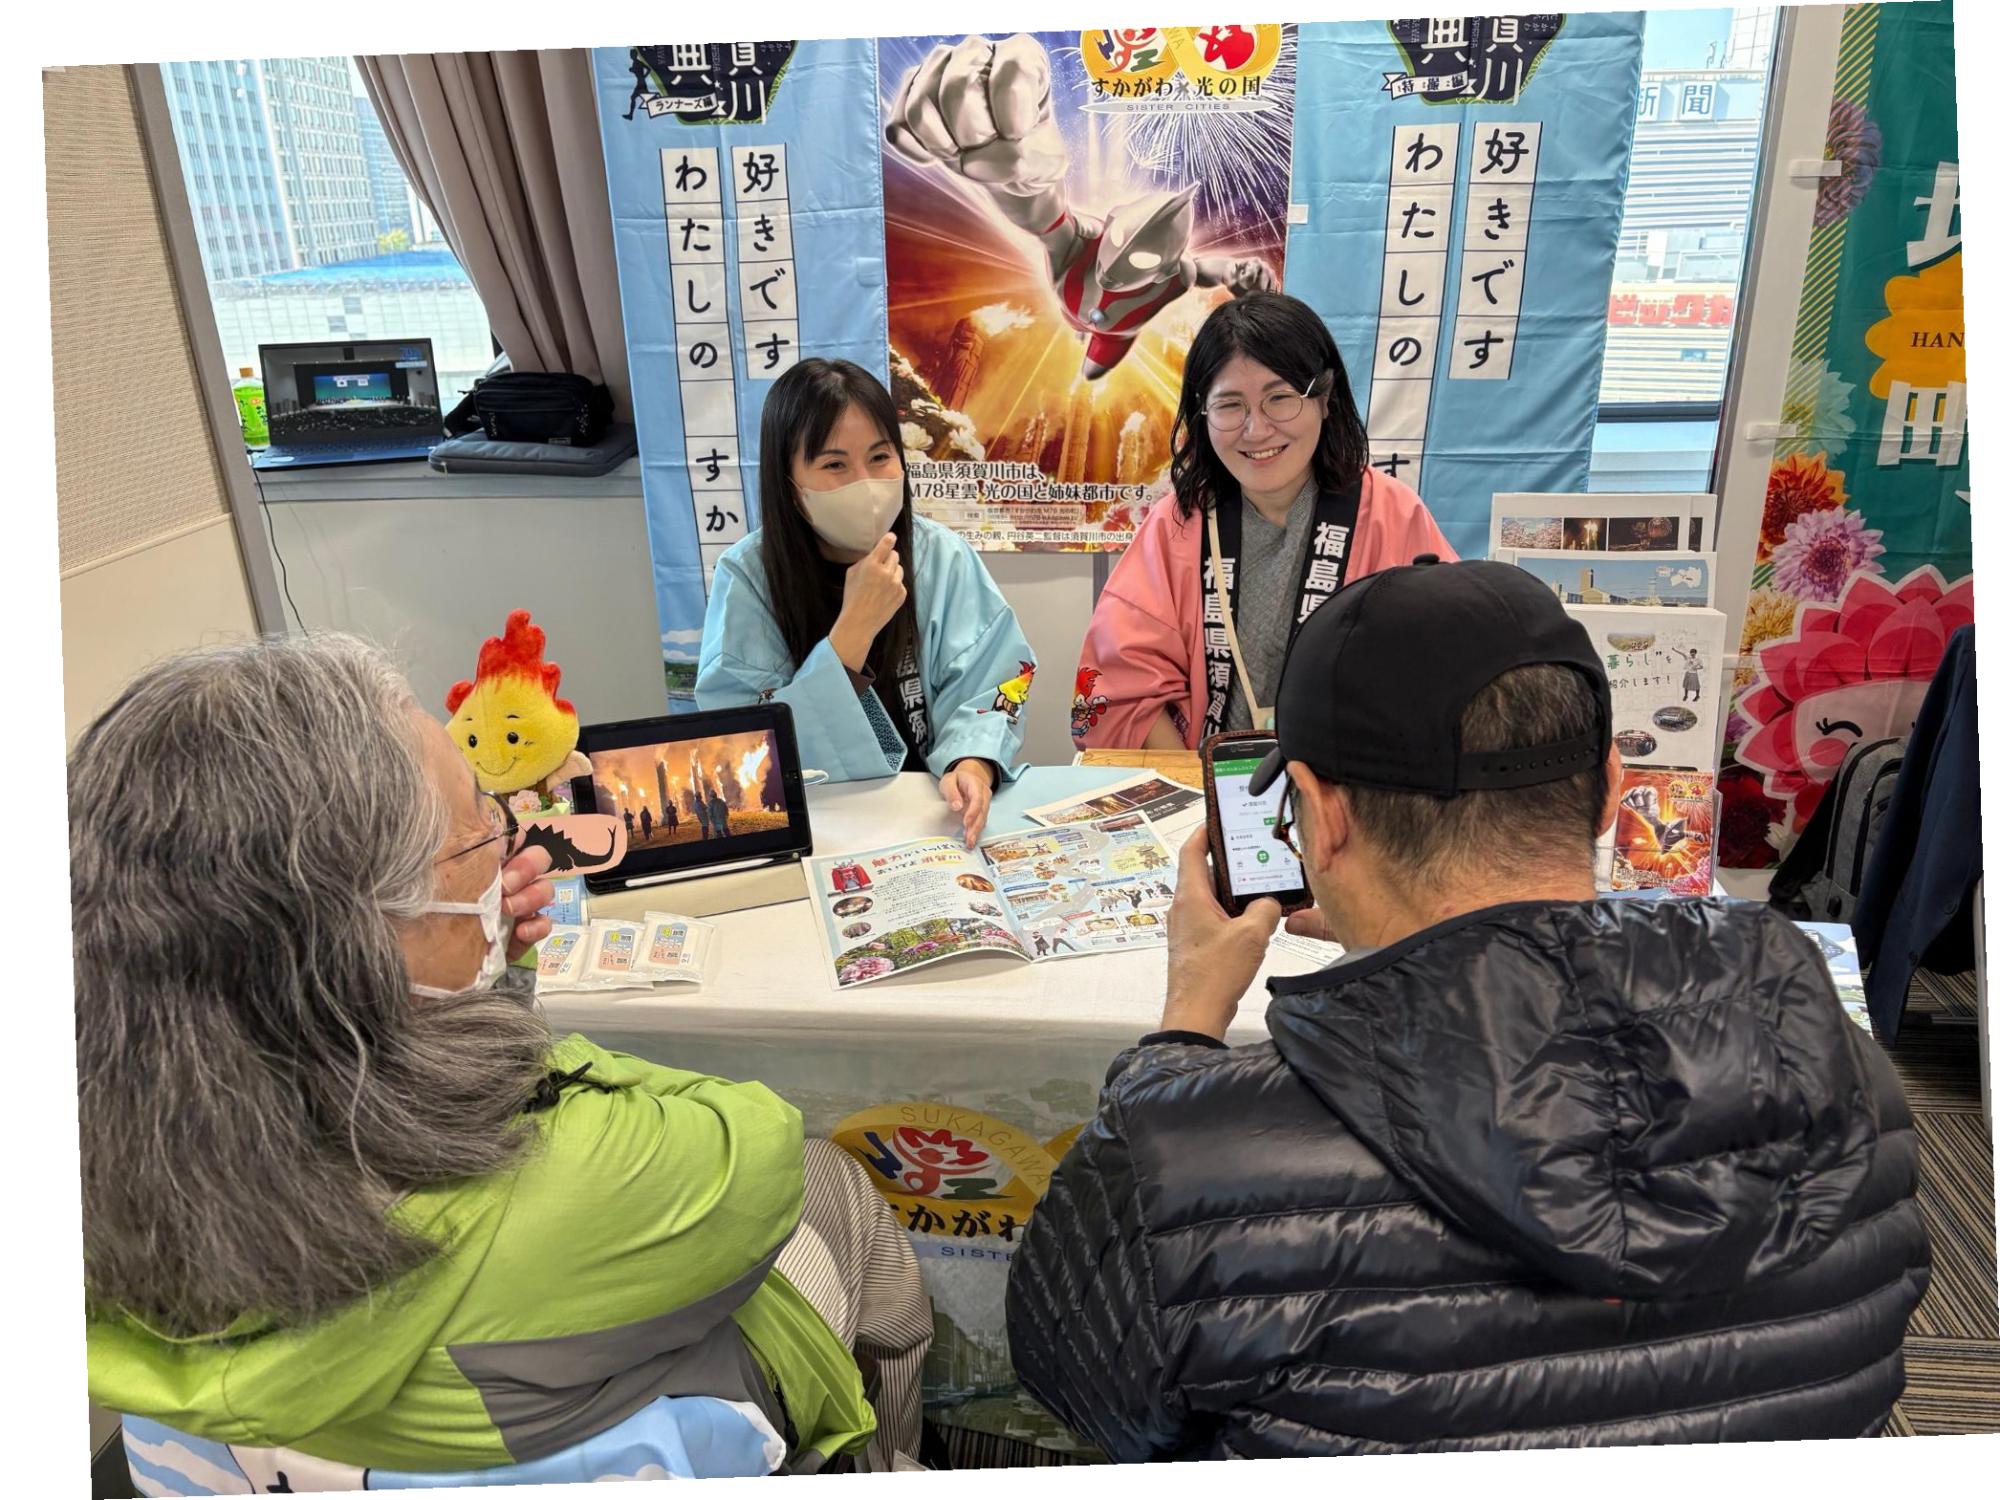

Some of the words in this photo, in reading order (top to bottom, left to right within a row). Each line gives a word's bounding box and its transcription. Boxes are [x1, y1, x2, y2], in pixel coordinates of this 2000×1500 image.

[1126, 103, 1174, 111] SISTER
[1184, 102, 1230, 110] CITIES
[675, 155, 718, 369] わたしの
[743, 152, 791, 369] 好きです
[1389, 133, 1443, 366] わたしの
[1464, 128, 1529, 369] 好きです
[696, 449, 739, 570] すか
[906, 462, 1045, 481] 福島県須賀川市は、
[900, 1105, 1050, 1186] SUKAGAWA
